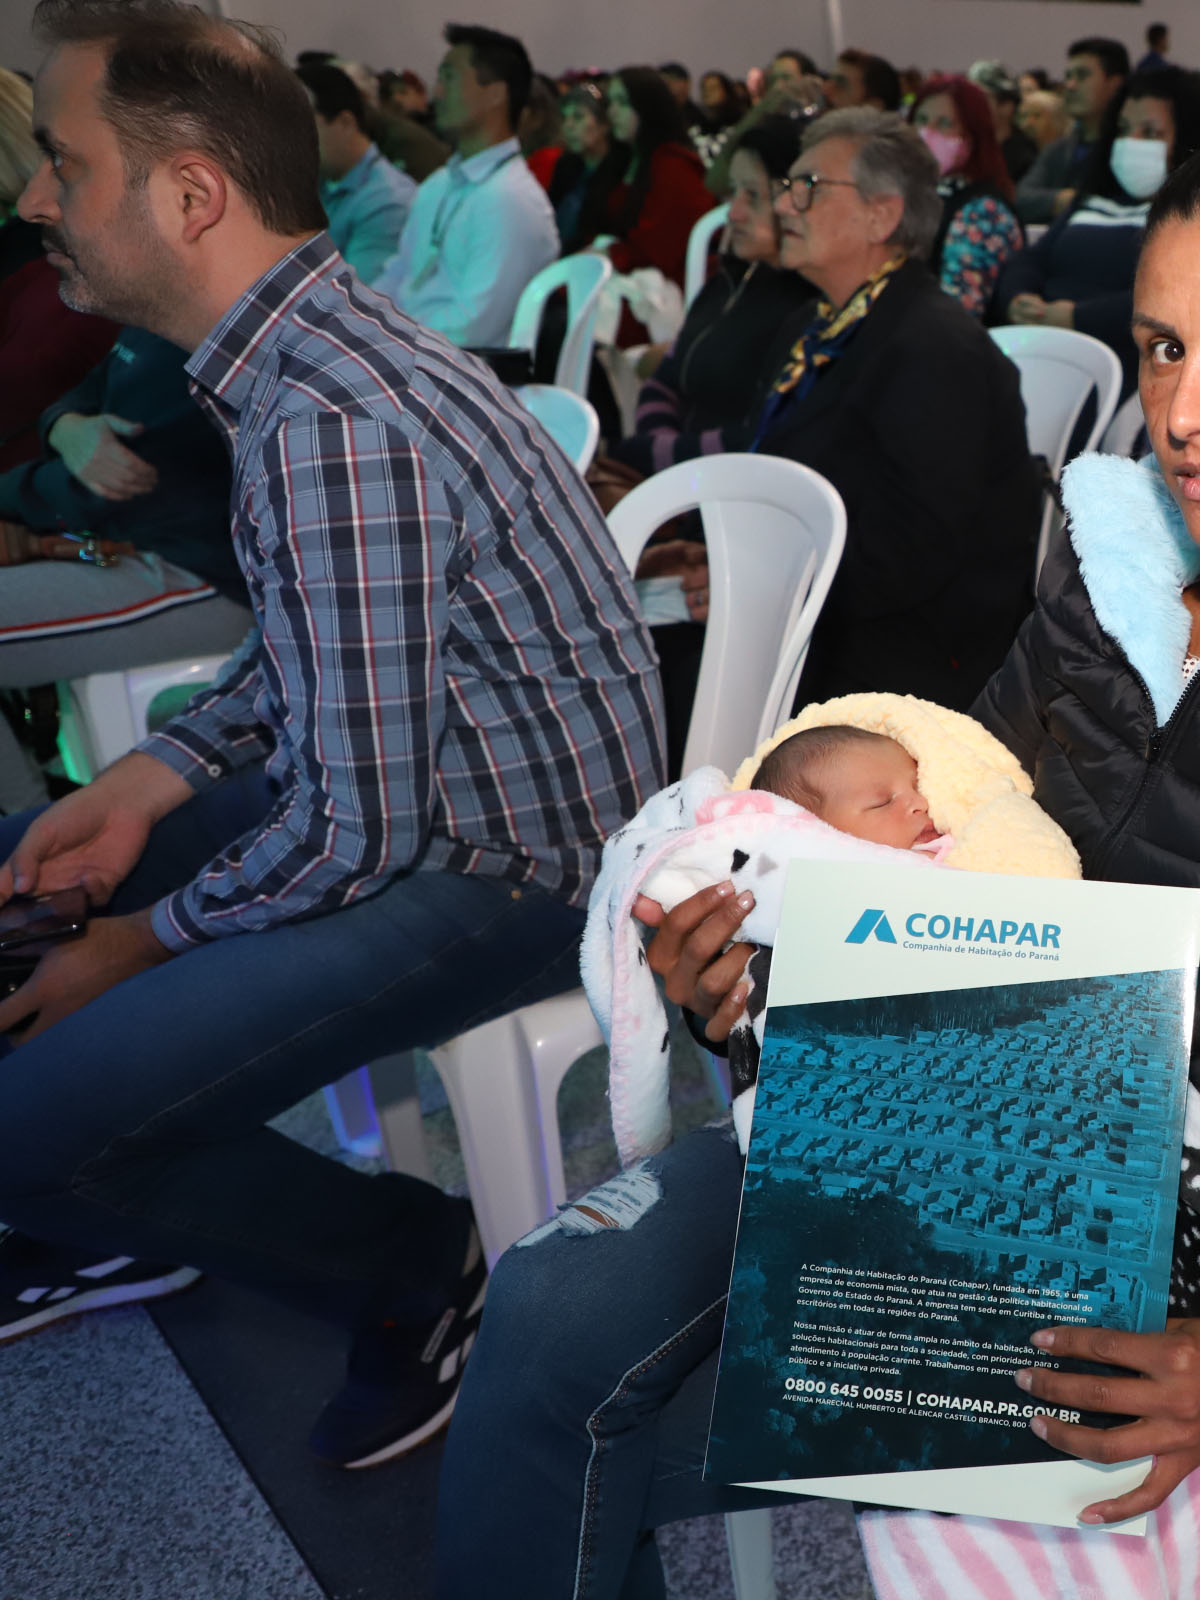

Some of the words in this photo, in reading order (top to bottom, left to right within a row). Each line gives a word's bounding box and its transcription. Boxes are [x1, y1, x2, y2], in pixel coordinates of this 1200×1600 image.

[905, 913, 1062, 948] COHAPAR
[903, 940, 952, 952] Companhia
[954, 946, 966, 954] de
[968, 946, 1012, 958] Habitação
[1014, 950, 1026, 958] do
[1029, 952, 1059, 962] Paraná
[800, 1276, 832, 1286] empresa
[834, 1278, 844, 1286] de
[846, 1281, 884, 1290] economia
[886, 1284, 910, 1294] mista,
[912, 1288, 926, 1296] que
[928, 1290, 945, 1298] atua
[958, 1292, 986, 1302] gestão
[1000, 1296, 1029, 1306] política
[1032, 1300, 1080, 1312] habitacional
[1082, 1304, 1092, 1312] do
[810, 1264, 852, 1276] Companhia
[854, 1268, 864, 1276] de
[867, 1270, 906, 1282] Habitação
[908, 1274, 918, 1282] do
[920, 1276, 946, 1286] Paraná
[949, 1279, 990, 1290] (Cohapar),
[993, 1284, 1025, 1294] fundada
[1042, 1288, 1062, 1298] 1965,
[1064, 1290, 1070, 1298] é
[796, 1298, 837, 1309] escritórios
[854, 1304, 874, 1314] todas
[888, 1308, 916, 1318] regiões
[918, 1311, 928, 1319] do
[931, 1312, 959, 1322] Paraná.
[798, 1286, 830, 1296] Governo
[846, 1292, 872, 1301] Estado
[886, 1296, 914, 1306] Paraná.
[926, 1301, 958, 1310] empresa
[978, 1306, 996, 1314] sede
[1014, 1310, 1044, 1320] Curitiba
[1054, 1314, 1086, 1324] mantém
[792, 1332, 826, 1343] soluções
[828, 1336, 879, 1349] habitacionais
[881, 1344, 898, 1352] para
[900, 1345, 918, 1354] toda
[928, 1348, 970, 1360] sociedade,
[990, 1355, 1032, 1366] prioridade
[1034, 1360, 1052, 1368] para
[794, 1320, 816, 1330] Nossa
[818, 1324, 845, 1334] missão
[854, 1328, 874, 1336] atuar
[876, 1330, 886, 1338] de
[888, 1332, 912, 1340] forma
[914, 1335, 938, 1344] ampla
[952, 1338, 980, 1348] âmbito
[994, 1344, 1035, 1355] habitação,
[788, 1356, 818, 1366] público
[834, 1360, 868, 1372] iniciativa
[870, 1365, 901, 1376] privada.
[790, 1344, 840, 1356] atendimento
[848, 1351, 889, 1362] população
[891, 1356, 922, 1366] carente.
[925, 1360, 974, 1372] Trabalhamos
[990, 1368, 1016, 1376] parcer
[782, 1394, 814, 1403] AVENIDA
[816, 1398, 854, 1408] MARECHAL
[856, 1402, 896, 1413] HUMBERTO
[908, 1408, 942, 1418] ALENCAR
[944, 1413, 976, 1422] CASTELO
[978, 1416, 1010, 1428] BRANCO,
[784, 1378, 826, 1394] 0800
[830, 1383, 859, 1398] 645
[863, 1387, 903, 1402] 0055
[916, 1393, 1080, 1424] COHAPAR.PR.GOV.BR
